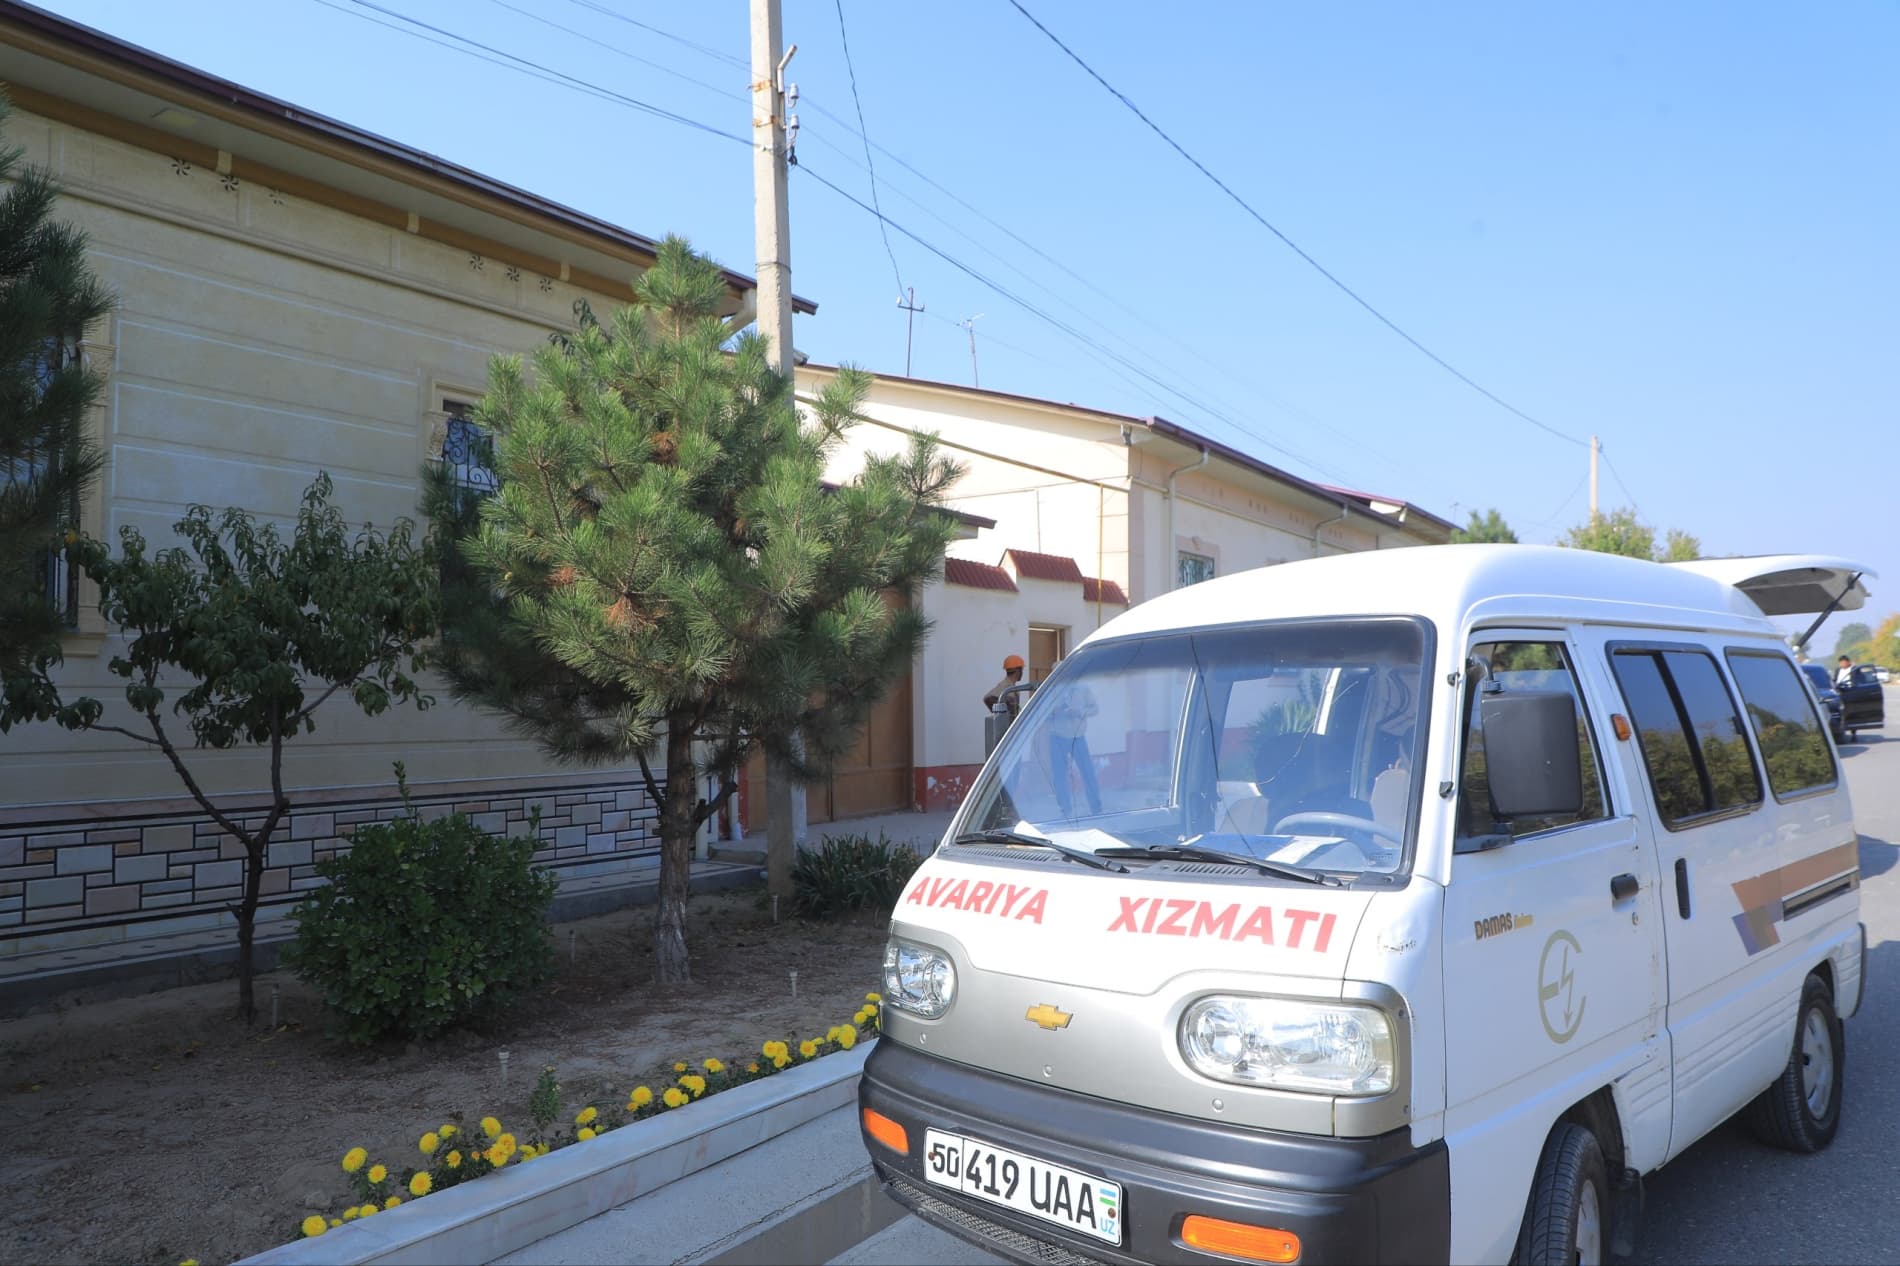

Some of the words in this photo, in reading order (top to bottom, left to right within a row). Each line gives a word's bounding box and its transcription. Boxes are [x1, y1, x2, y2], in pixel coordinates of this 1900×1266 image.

[906, 876, 1049, 925] AVARIYA
[1106, 896, 1338, 953] XIZMATI
[1474, 912, 1513, 940] DAMAS
[932, 1142, 960, 1178] 50
[965, 1149, 1020, 1200] 419
[1030, 1166, 1097, 1230] UAA
[1100, 1217, 1116, 1236] UZ
